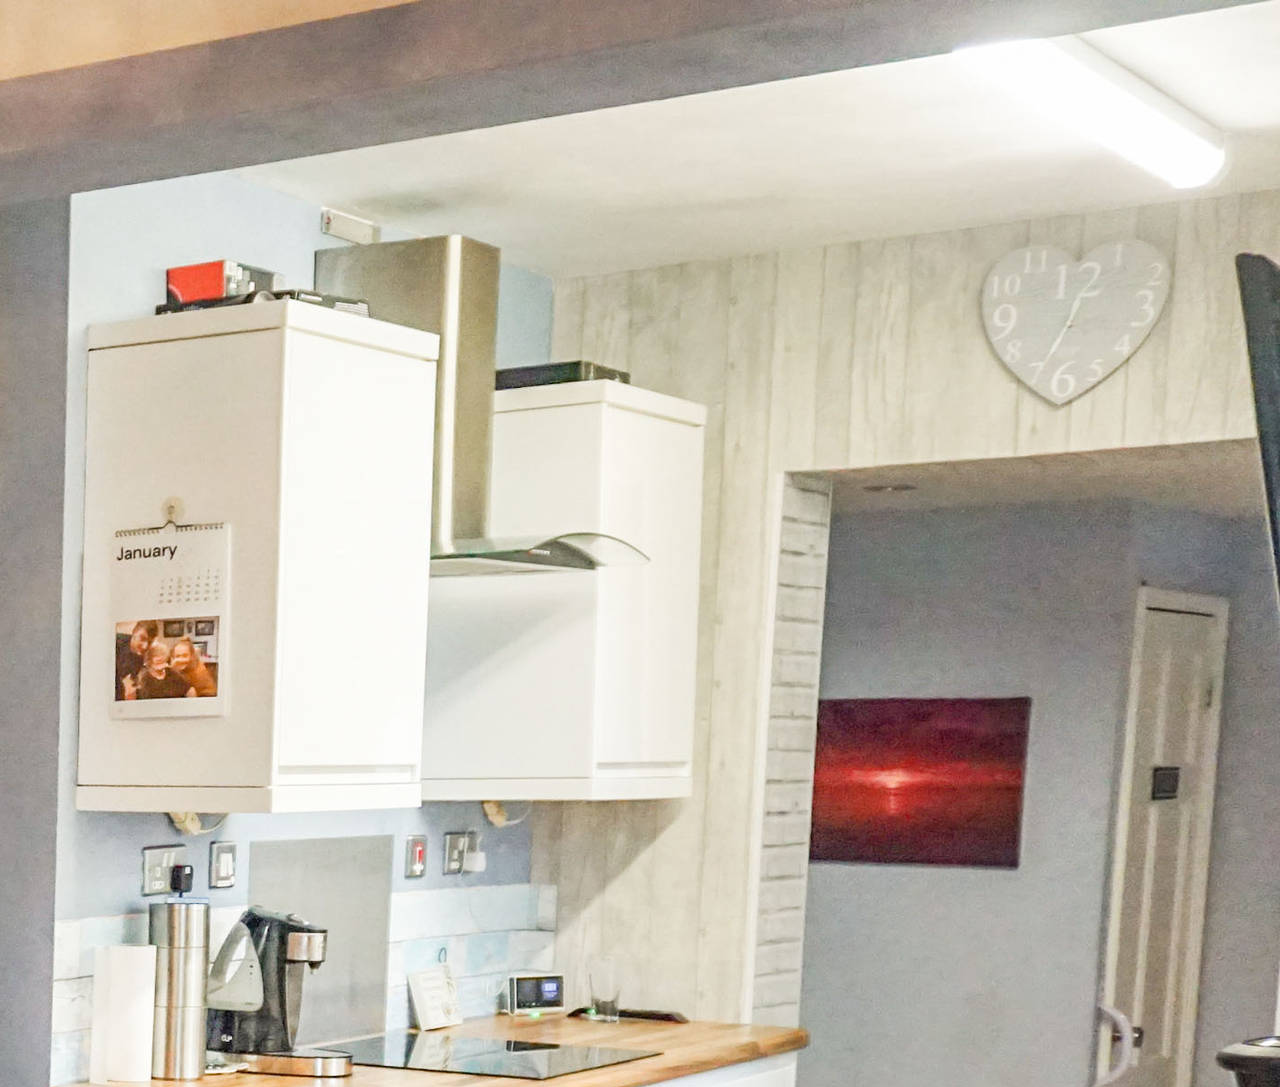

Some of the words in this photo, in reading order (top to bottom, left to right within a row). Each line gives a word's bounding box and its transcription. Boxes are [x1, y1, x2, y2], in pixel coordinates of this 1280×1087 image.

[1024, 249, 1048, 273] 11
[1114, 243, 1124, 266] 1
[990, 273, 1022, 297] 10
[1055, 261, 1103, 299] 12
[1147, 262, 1163, 286] 2
[1130, 289, 1155, 327] 3
[992, 303, 1017, 342] 9
[1004, 339, 1022, 363] 8
[1114, 333, 1132, 355] 4
[1028, 361, 1045, 384] 7
[1050, 360, 1077, 398] 6
[1087, 359, 1104, 382] 5
[116, 545, 178, 561] January
